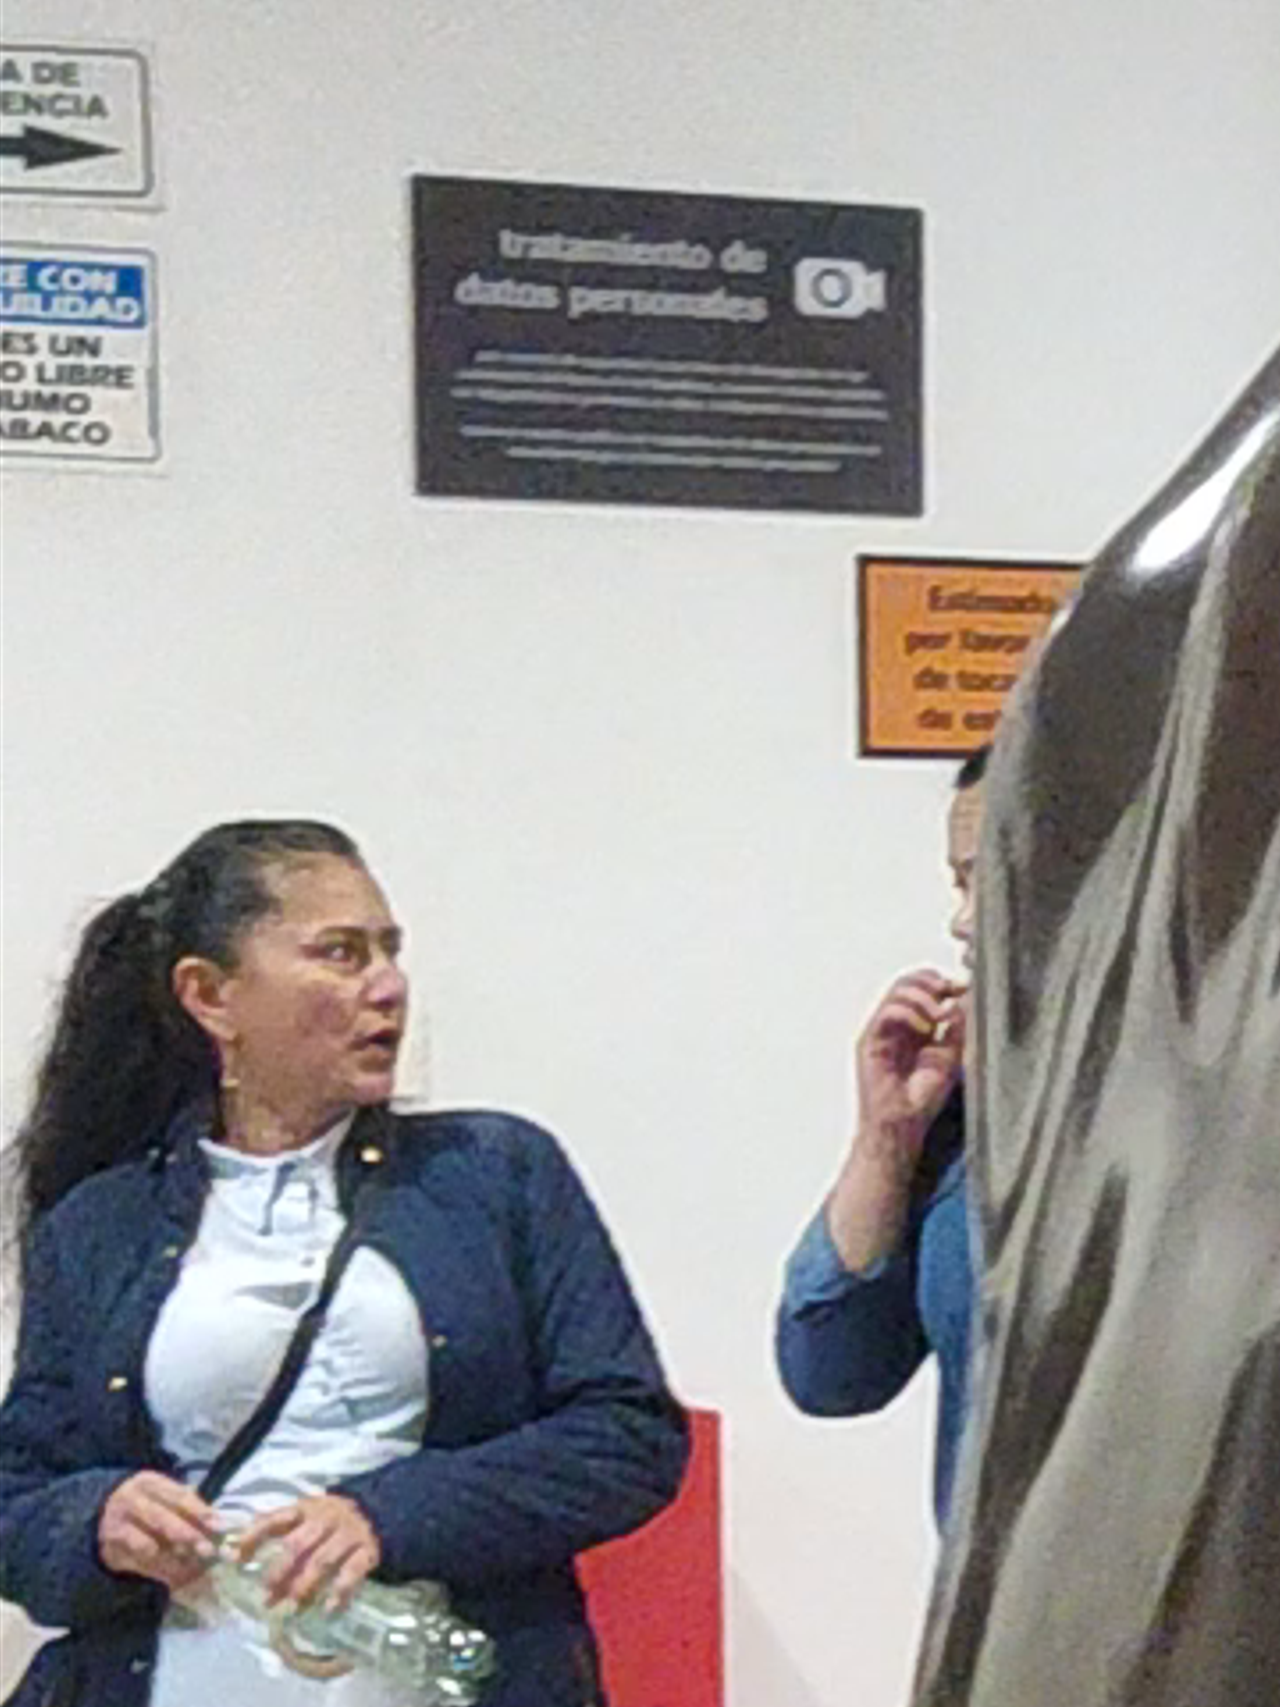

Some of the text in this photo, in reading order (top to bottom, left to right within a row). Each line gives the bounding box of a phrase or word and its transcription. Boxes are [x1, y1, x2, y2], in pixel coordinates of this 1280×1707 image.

[31, 62, 80, 88] DE
[720, 240, 768, 273] de
[38, 264, 117, 294] CON
[48, 334, 102, 359] UN
[35, 361, 135, 390] LIBRE
